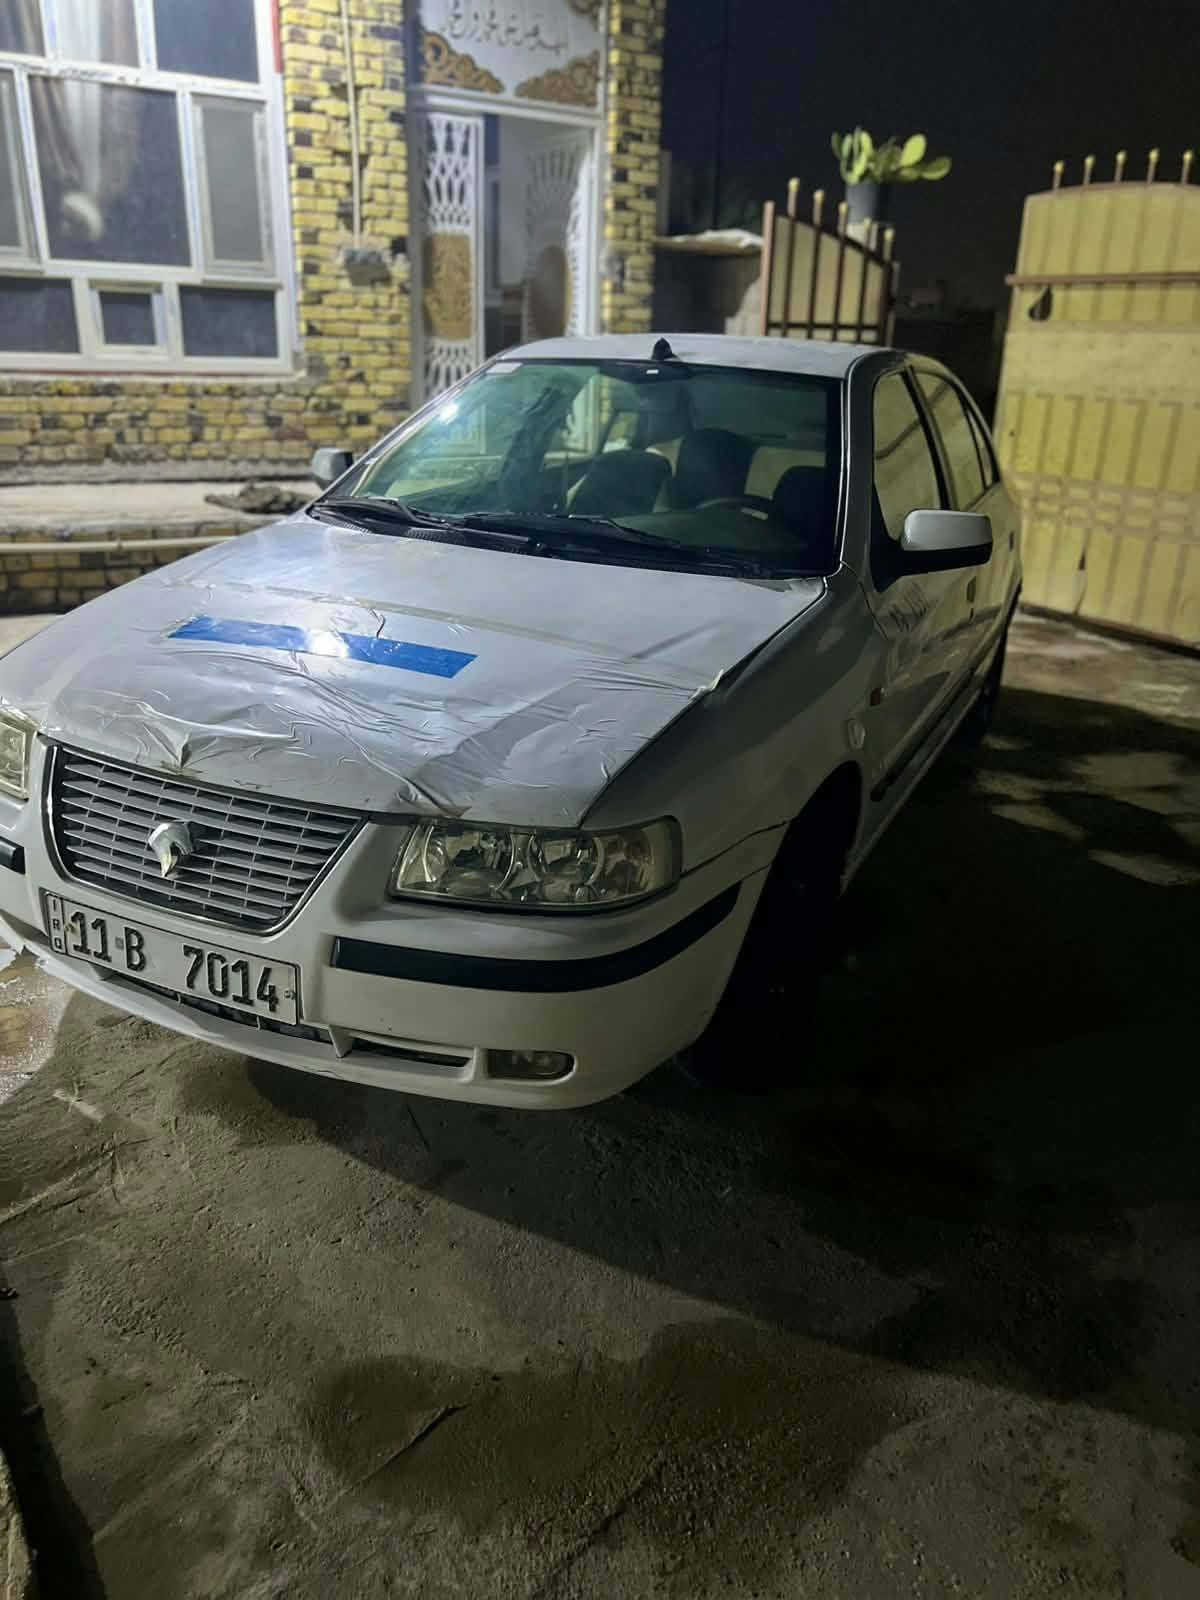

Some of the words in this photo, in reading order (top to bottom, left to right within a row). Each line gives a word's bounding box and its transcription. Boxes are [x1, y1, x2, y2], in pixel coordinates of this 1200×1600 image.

[71, 911, 112, 963] 11
[124, 926, 147, 972] B
[183, 944, 279, 1013] 7014
